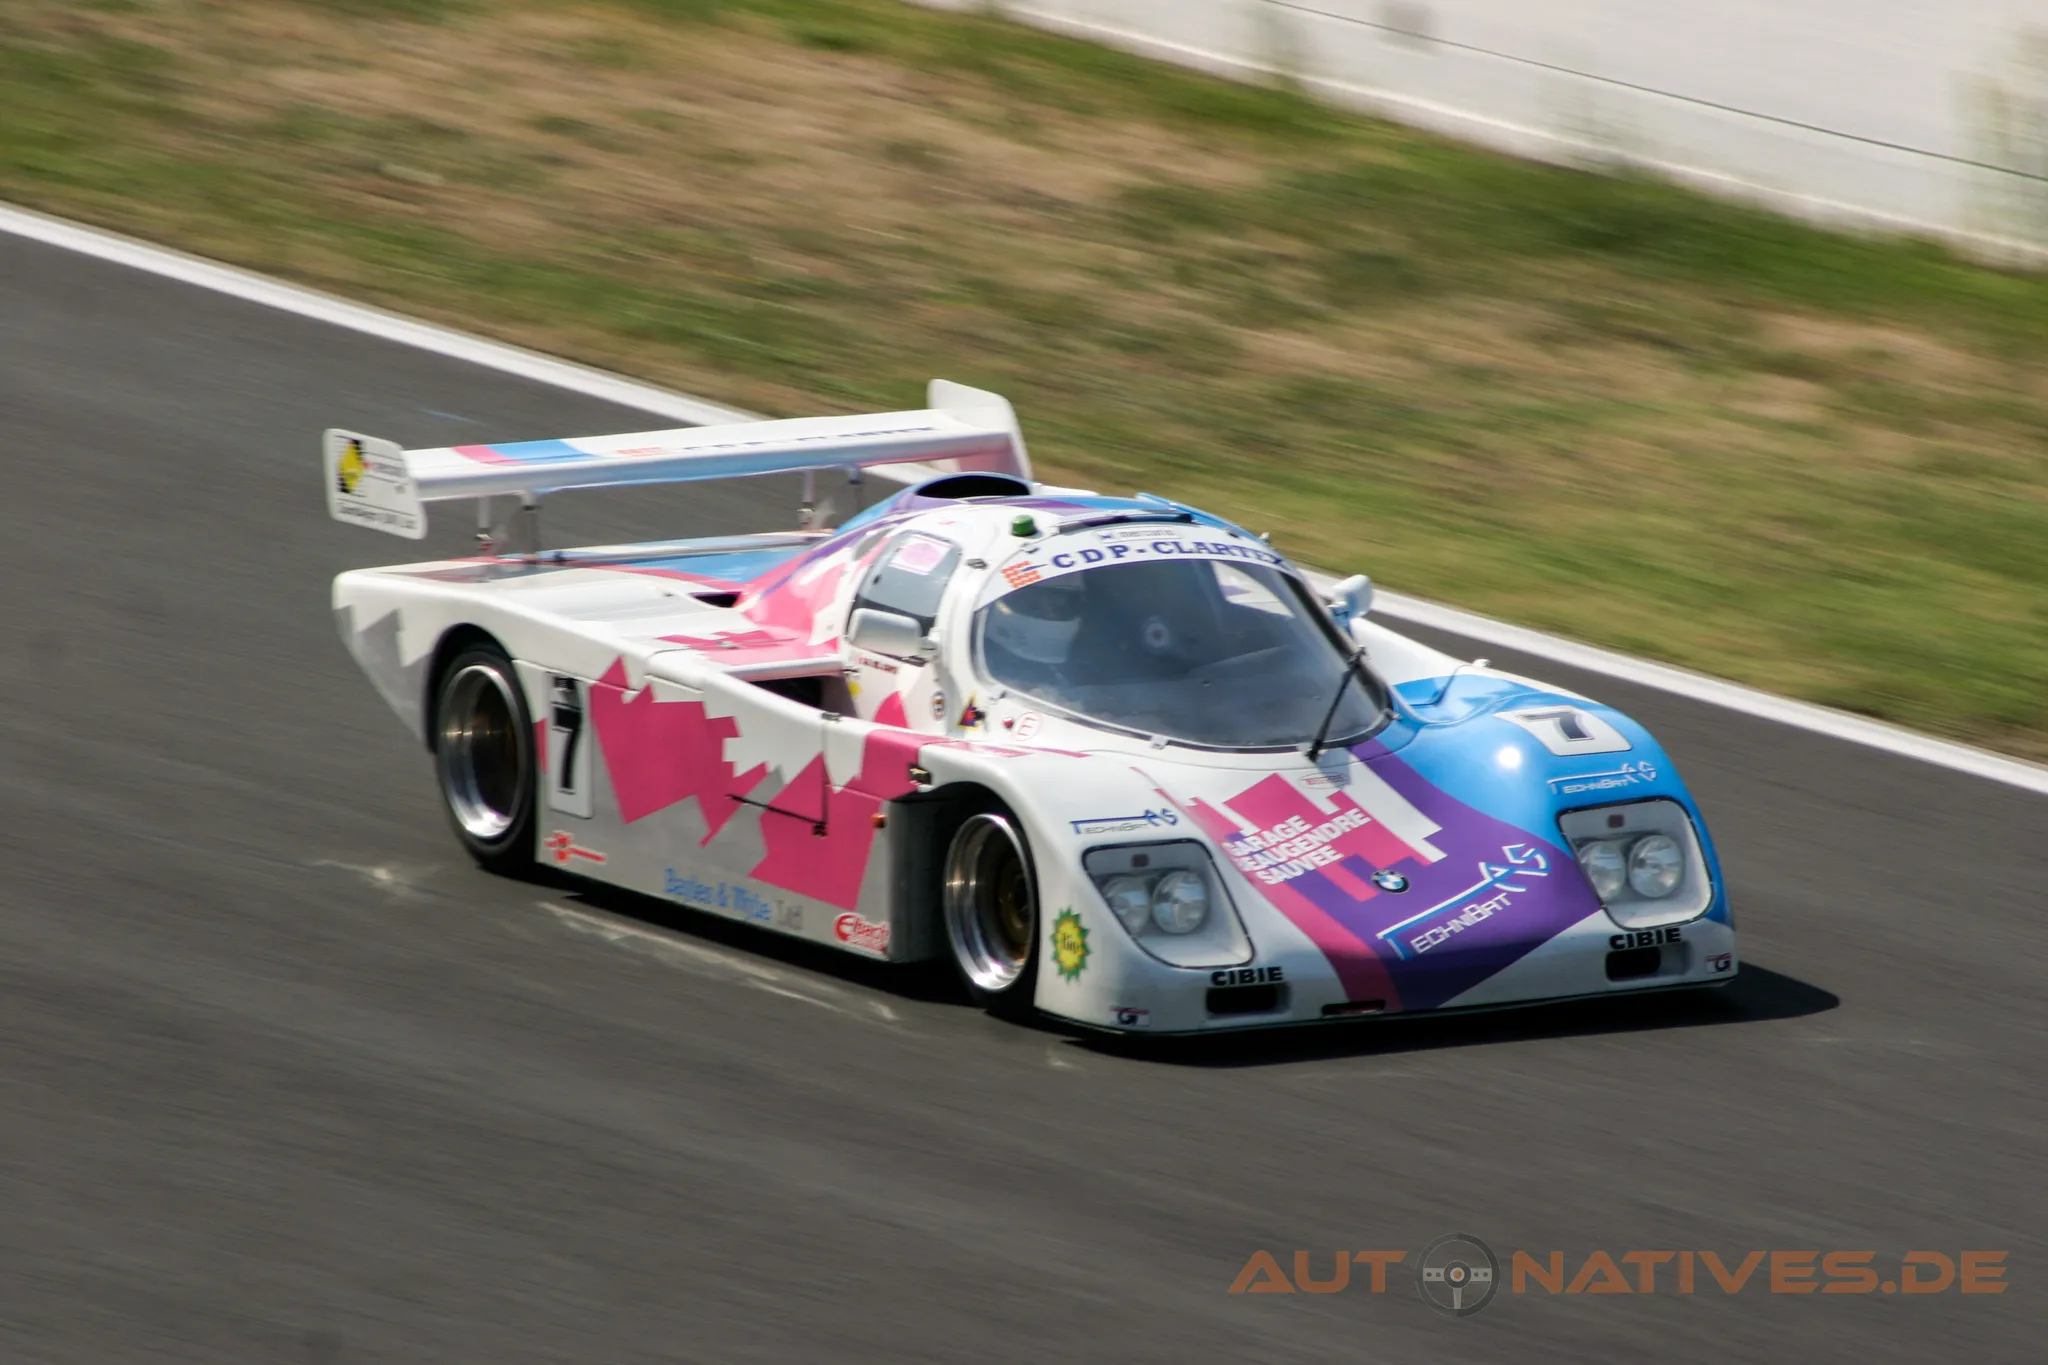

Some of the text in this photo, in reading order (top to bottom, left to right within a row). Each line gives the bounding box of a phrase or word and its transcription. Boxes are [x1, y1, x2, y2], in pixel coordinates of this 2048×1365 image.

[1518, 710, 1595, 742] 7
[551, 703, 583, 795] 7
[1220, 815, 1312, 857] GARAGE
[1231, 807, 1373, 872] BEAUGENDRE
[1256, 845, 1344, 885] SAUVEE
[1609, 927, 1681, 949] CIBIE
[1211, 966, 1284, 986] CIBIE
